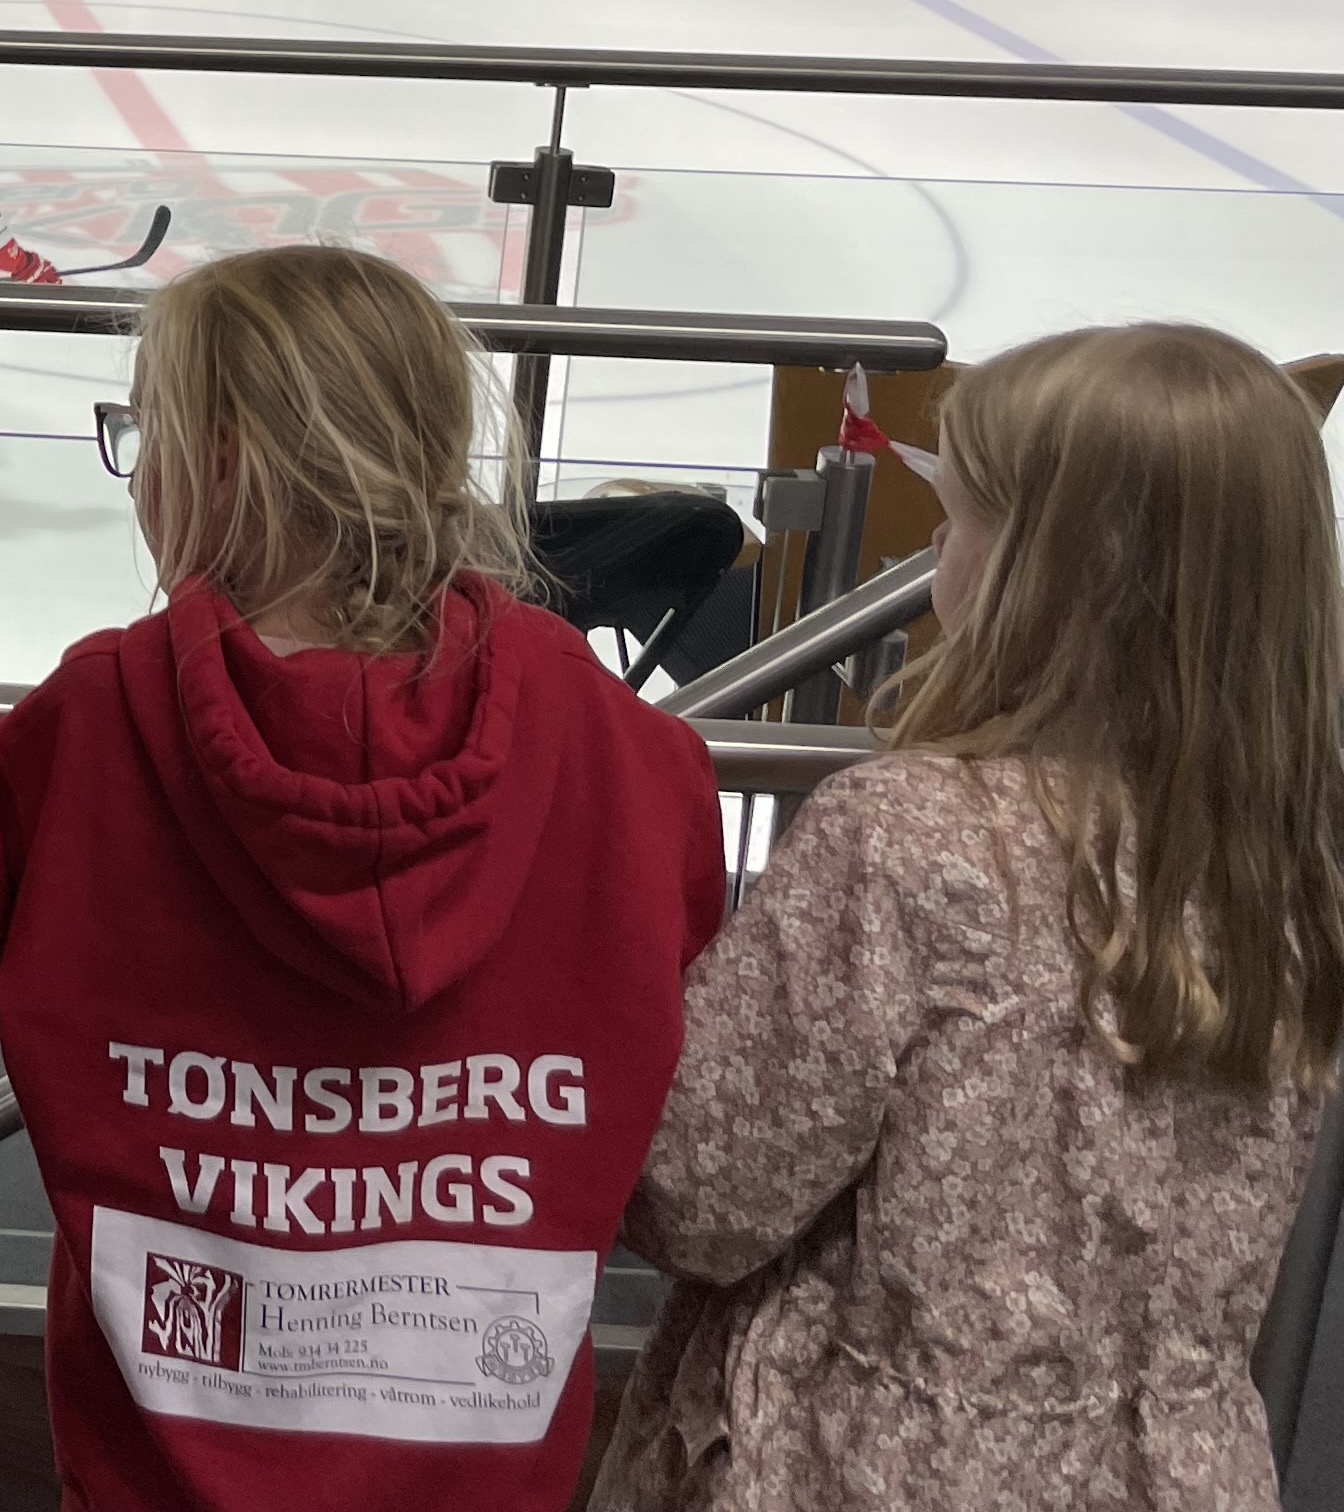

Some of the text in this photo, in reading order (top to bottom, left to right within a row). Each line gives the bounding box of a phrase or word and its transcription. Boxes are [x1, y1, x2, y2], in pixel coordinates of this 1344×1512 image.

[109, 1041, 587, 1133] TØNSBERG
[159, 1145, 535, 1235] VIKINGS
[260, 1302, 479, 1334] Henning Berntsen
[138, 1362, 541, 1410] nybygg tilbygg rehabilitering våtrom vedlikehold
